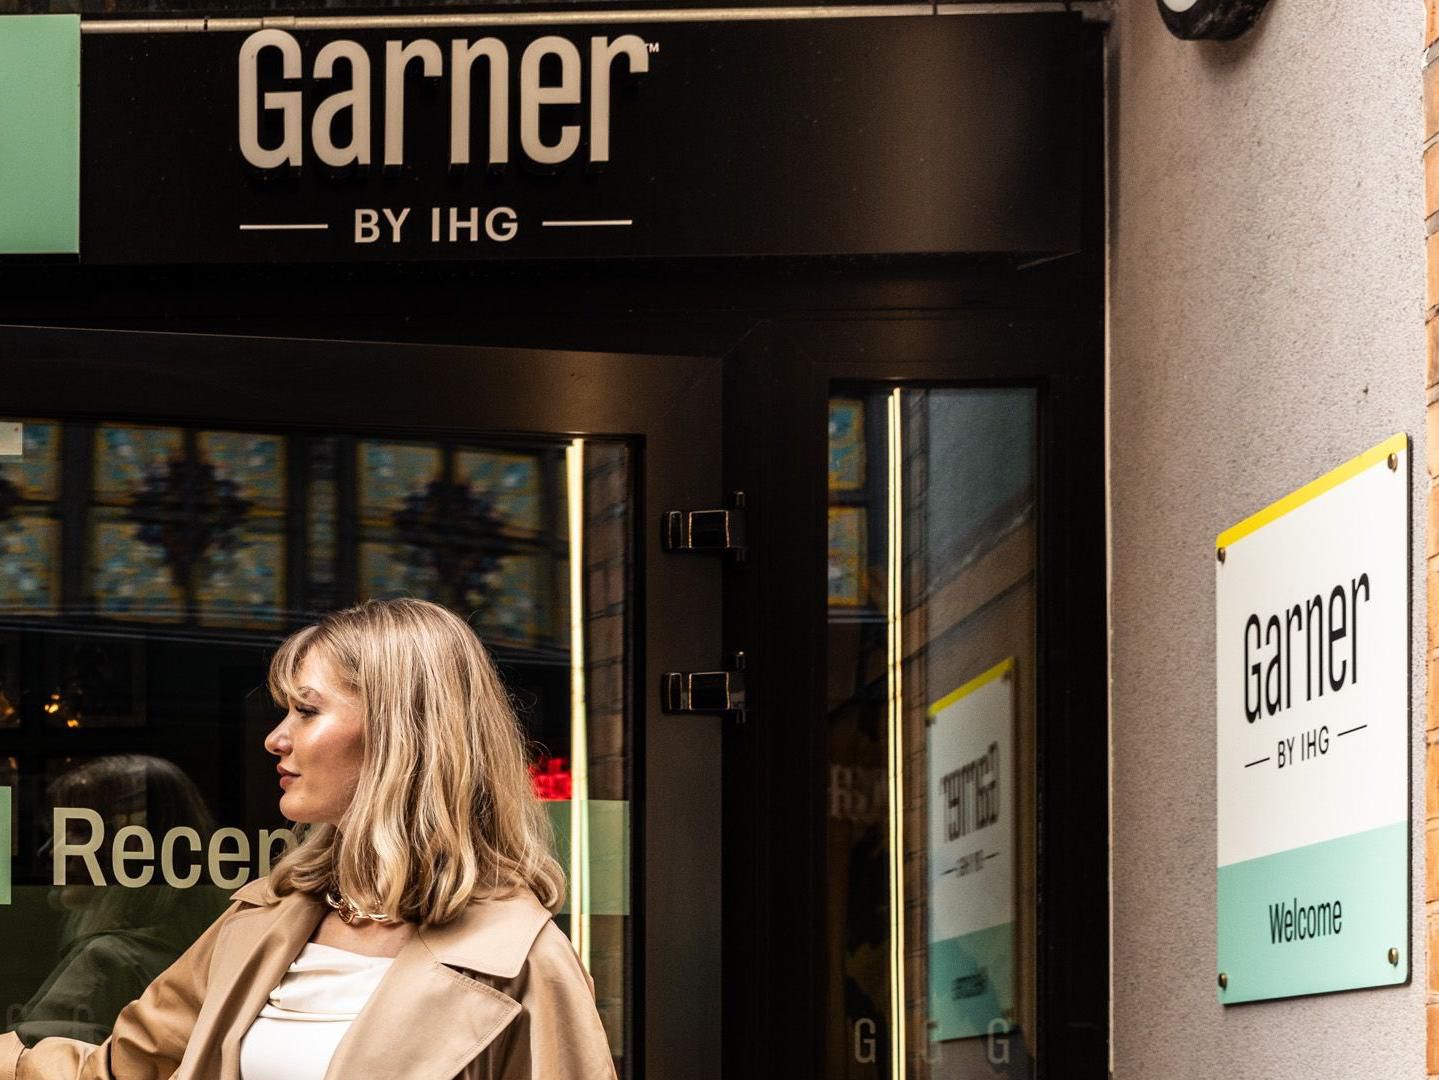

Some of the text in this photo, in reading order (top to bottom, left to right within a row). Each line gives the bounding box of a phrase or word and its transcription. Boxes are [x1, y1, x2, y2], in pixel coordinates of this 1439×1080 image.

[354, 207, 518, 243] BY IHG
[1244, 572, 1370, 725] Garner
[1277, 726, 1330, 769] BY IHG
[53, 806, 299, 890] Recep
[1269, 897, 1342, 945] Welcome
